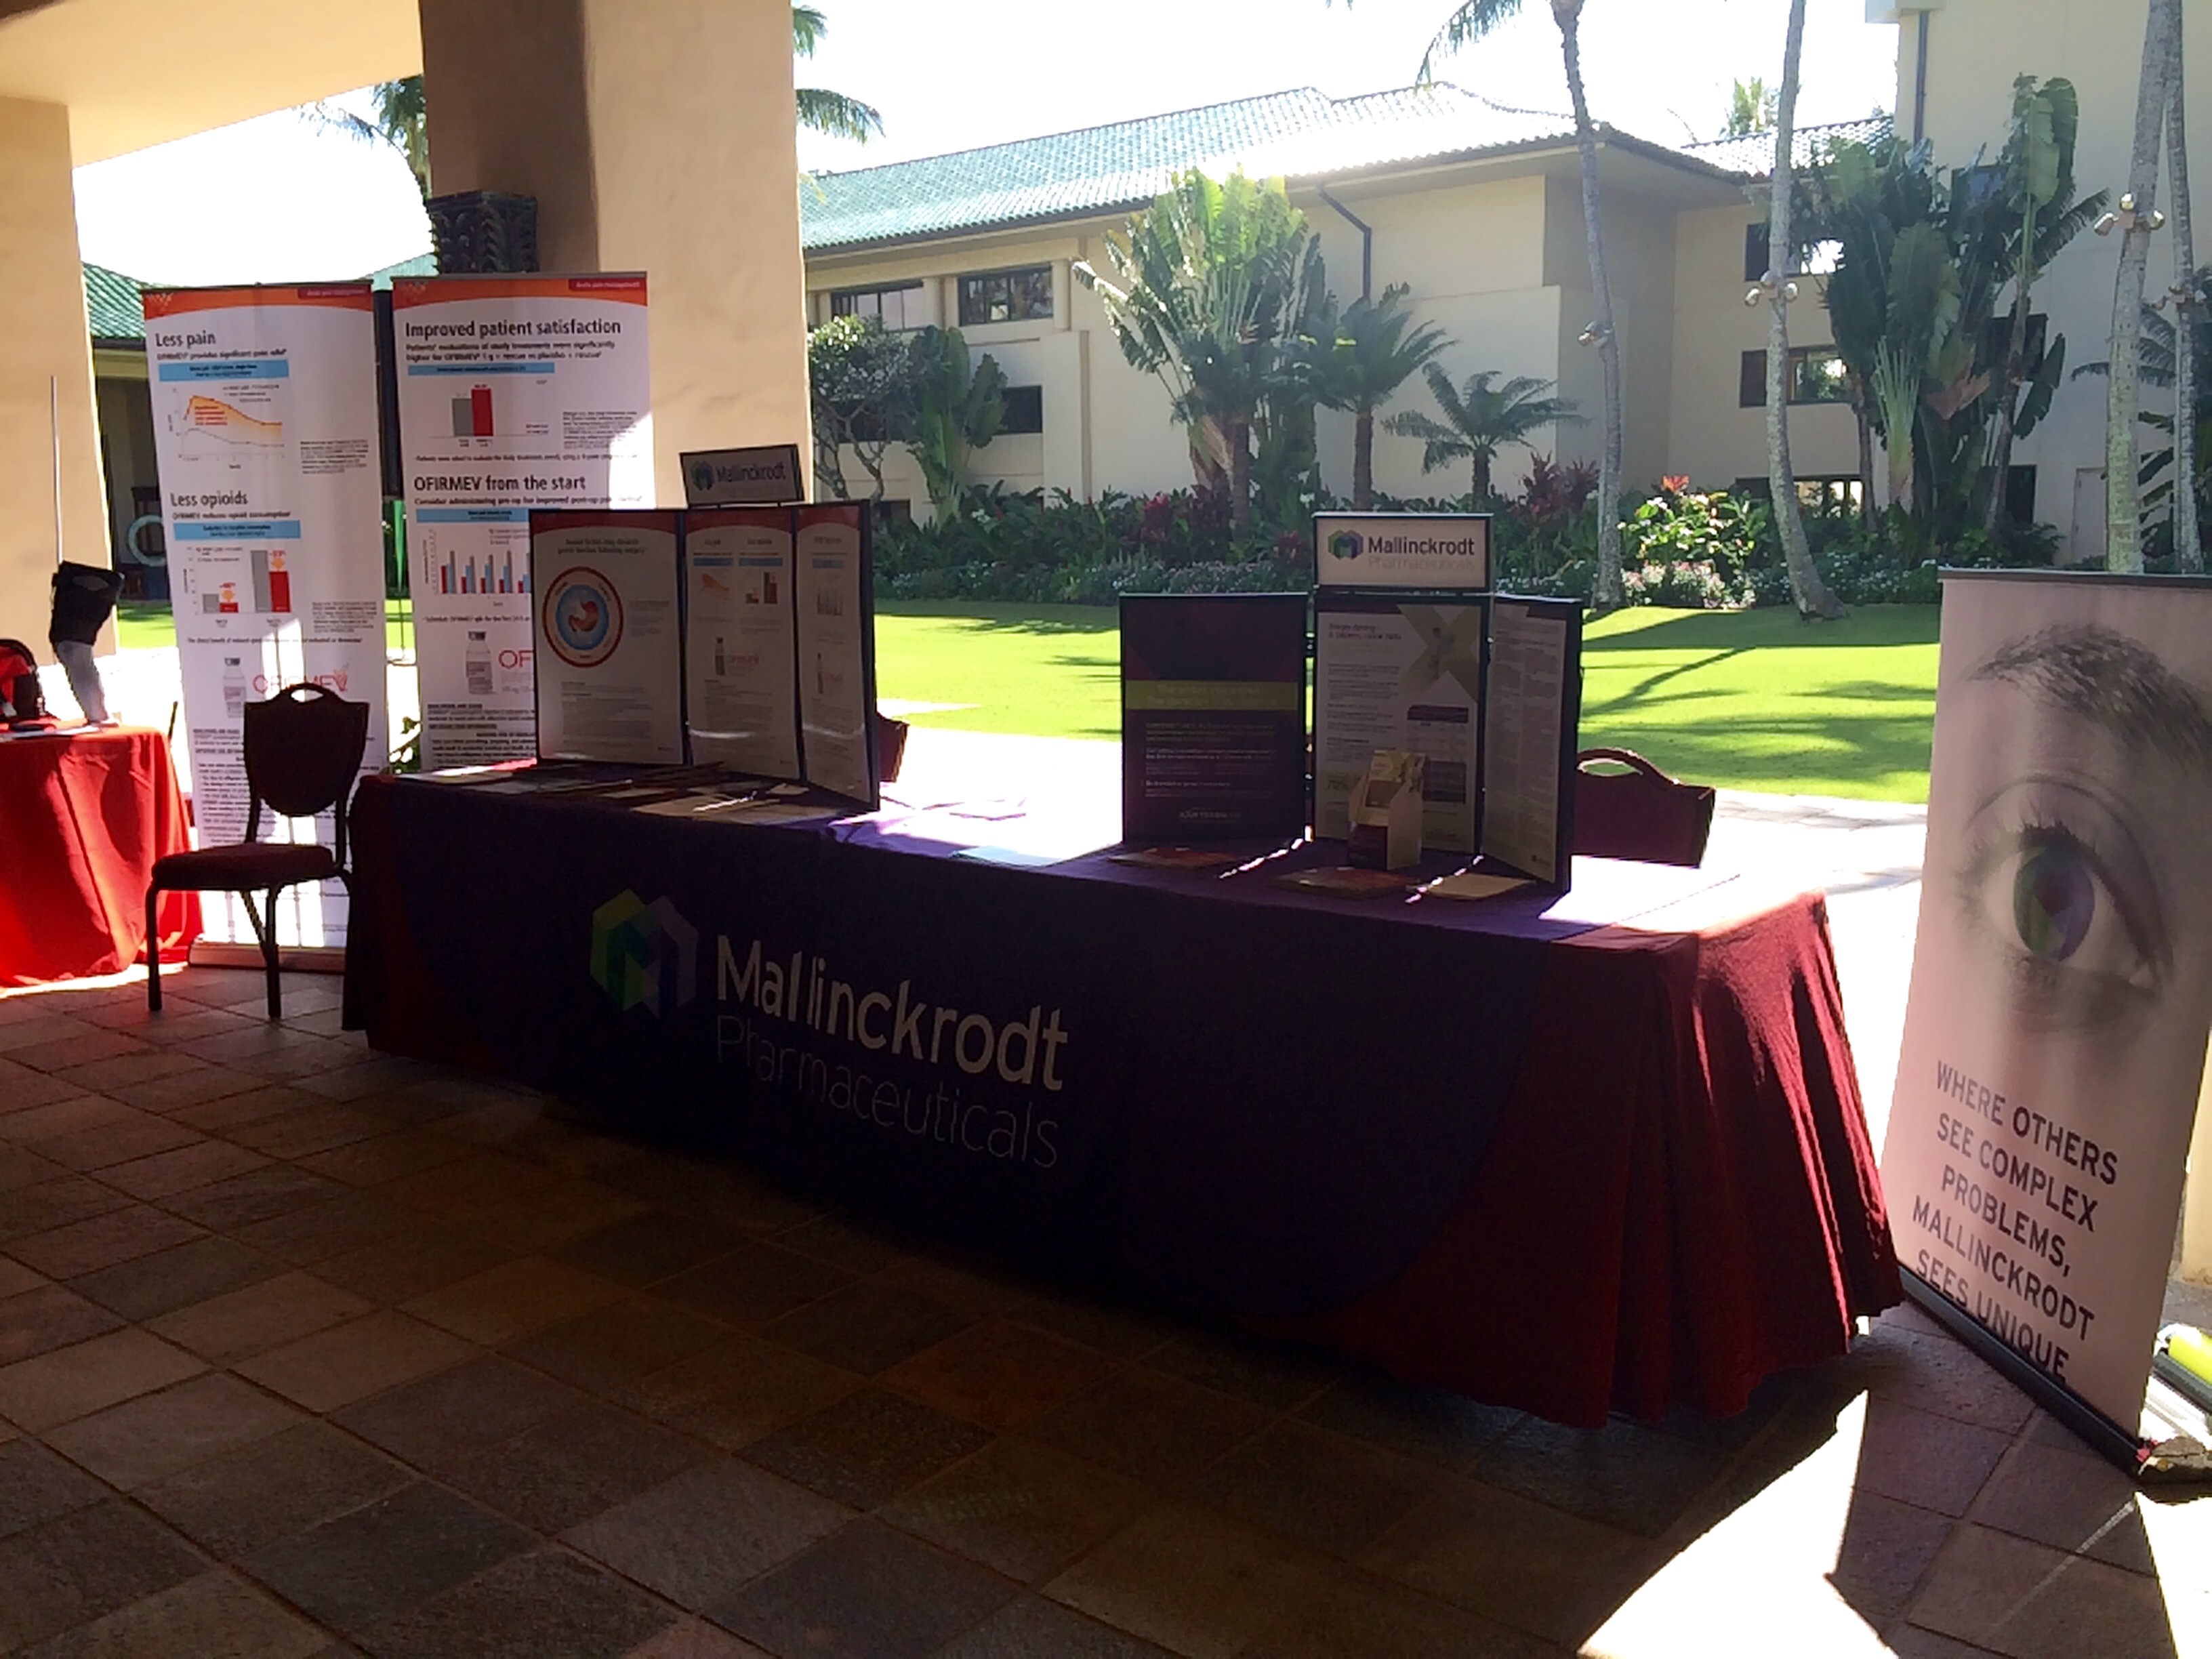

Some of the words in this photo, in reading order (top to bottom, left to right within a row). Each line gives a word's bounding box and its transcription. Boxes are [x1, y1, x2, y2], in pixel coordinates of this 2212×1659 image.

[155, 333, 184, 347] Less
[187, 330, 216, 349] pain
[405, 321, 474, 340] Improved
[480, 319, 532, 339] patient
[537, 318, 621, 335] satisfaction
[171, 493, 197, 507] Less
[201, 490, 248, 509] opioids
[415, 476, 482, 491] OFIRMEV
[486, 475, 519, 491] from
[524, 475, 548, 490] the
[552, 476, 586, 491] start
[1368, 535, 1475, 556] Mallinckrodt
[1368, 556, 1475, 573] Pharmaceuticals
[716, 934, 1069, 1091] Mallinckrodt
[716, 1015, 1059, 1169] Pharmaceuticals
[1937, 1061, 2006, 1126] WHERE
[2013, 1107, 2118, 1185] OTHERS
[1937, 1112, 1973, 1158] SEE
[1979, 1140, 2098, 1233] COMPLEX
[1941, 1165, 2070, 1277] PROBLEMS,
[1912, 1195, 2095, 1341] MALLINCKRODT
[1915, 1249, 1969, 1304] SEES
[1977, 1290, 2070, 1382] UNIQUE
